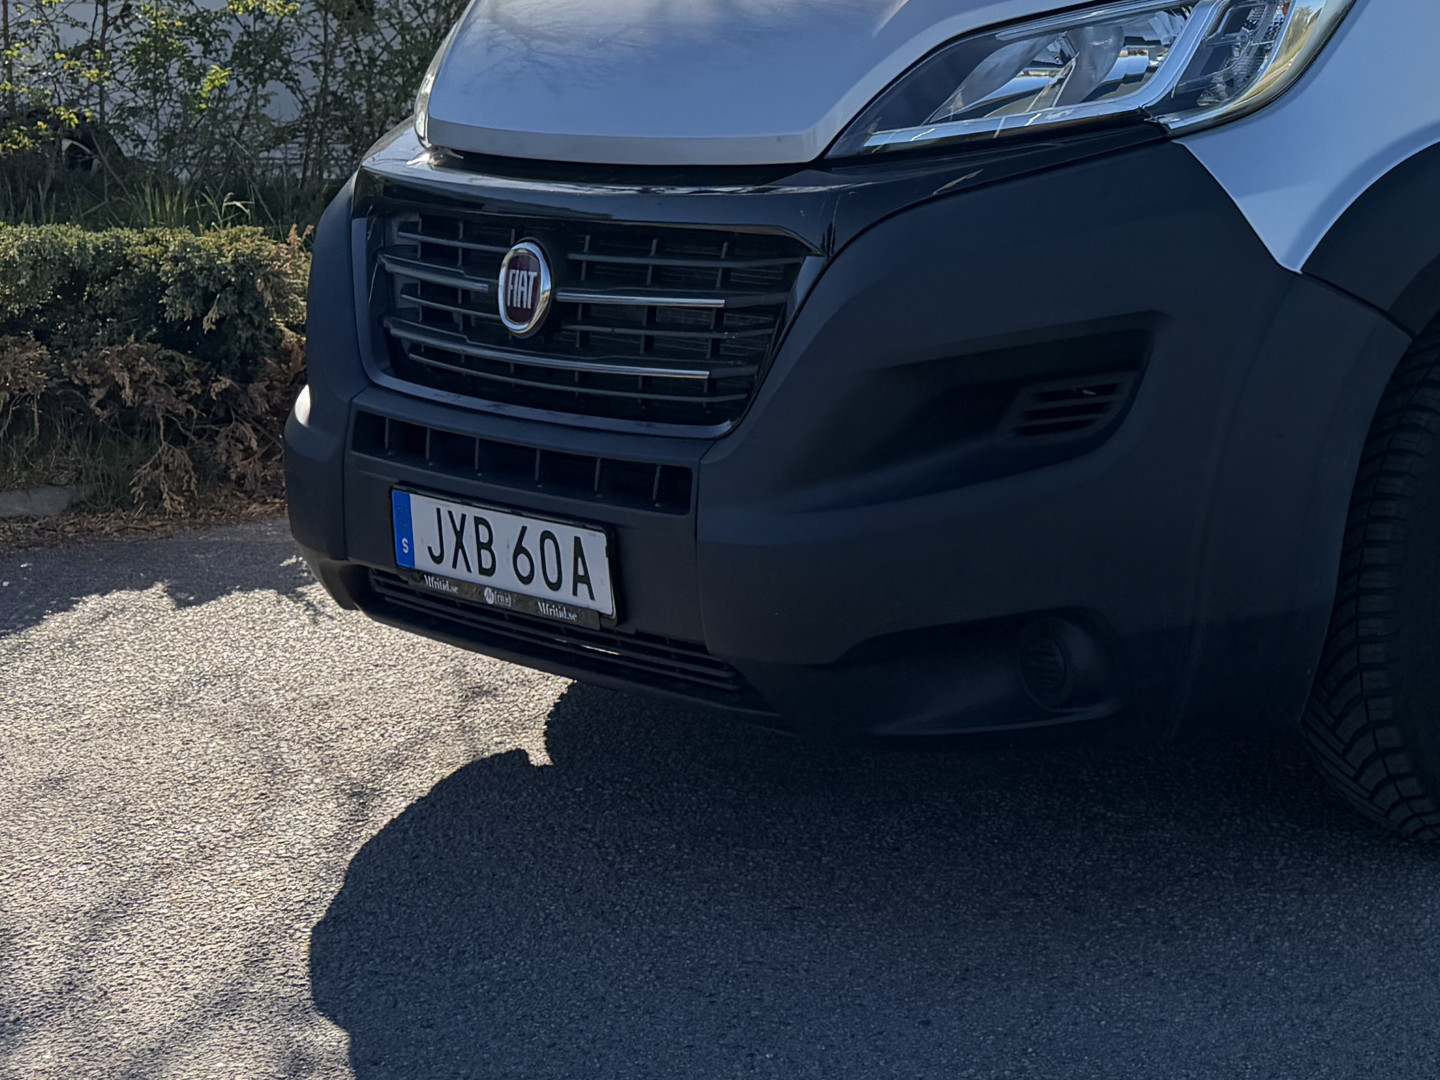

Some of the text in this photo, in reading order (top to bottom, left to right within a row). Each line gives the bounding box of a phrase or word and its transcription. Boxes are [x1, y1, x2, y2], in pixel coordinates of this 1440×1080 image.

[507, 269, 537, 309] FIAT
[402, 507, 596, 601] S JXB 60A
